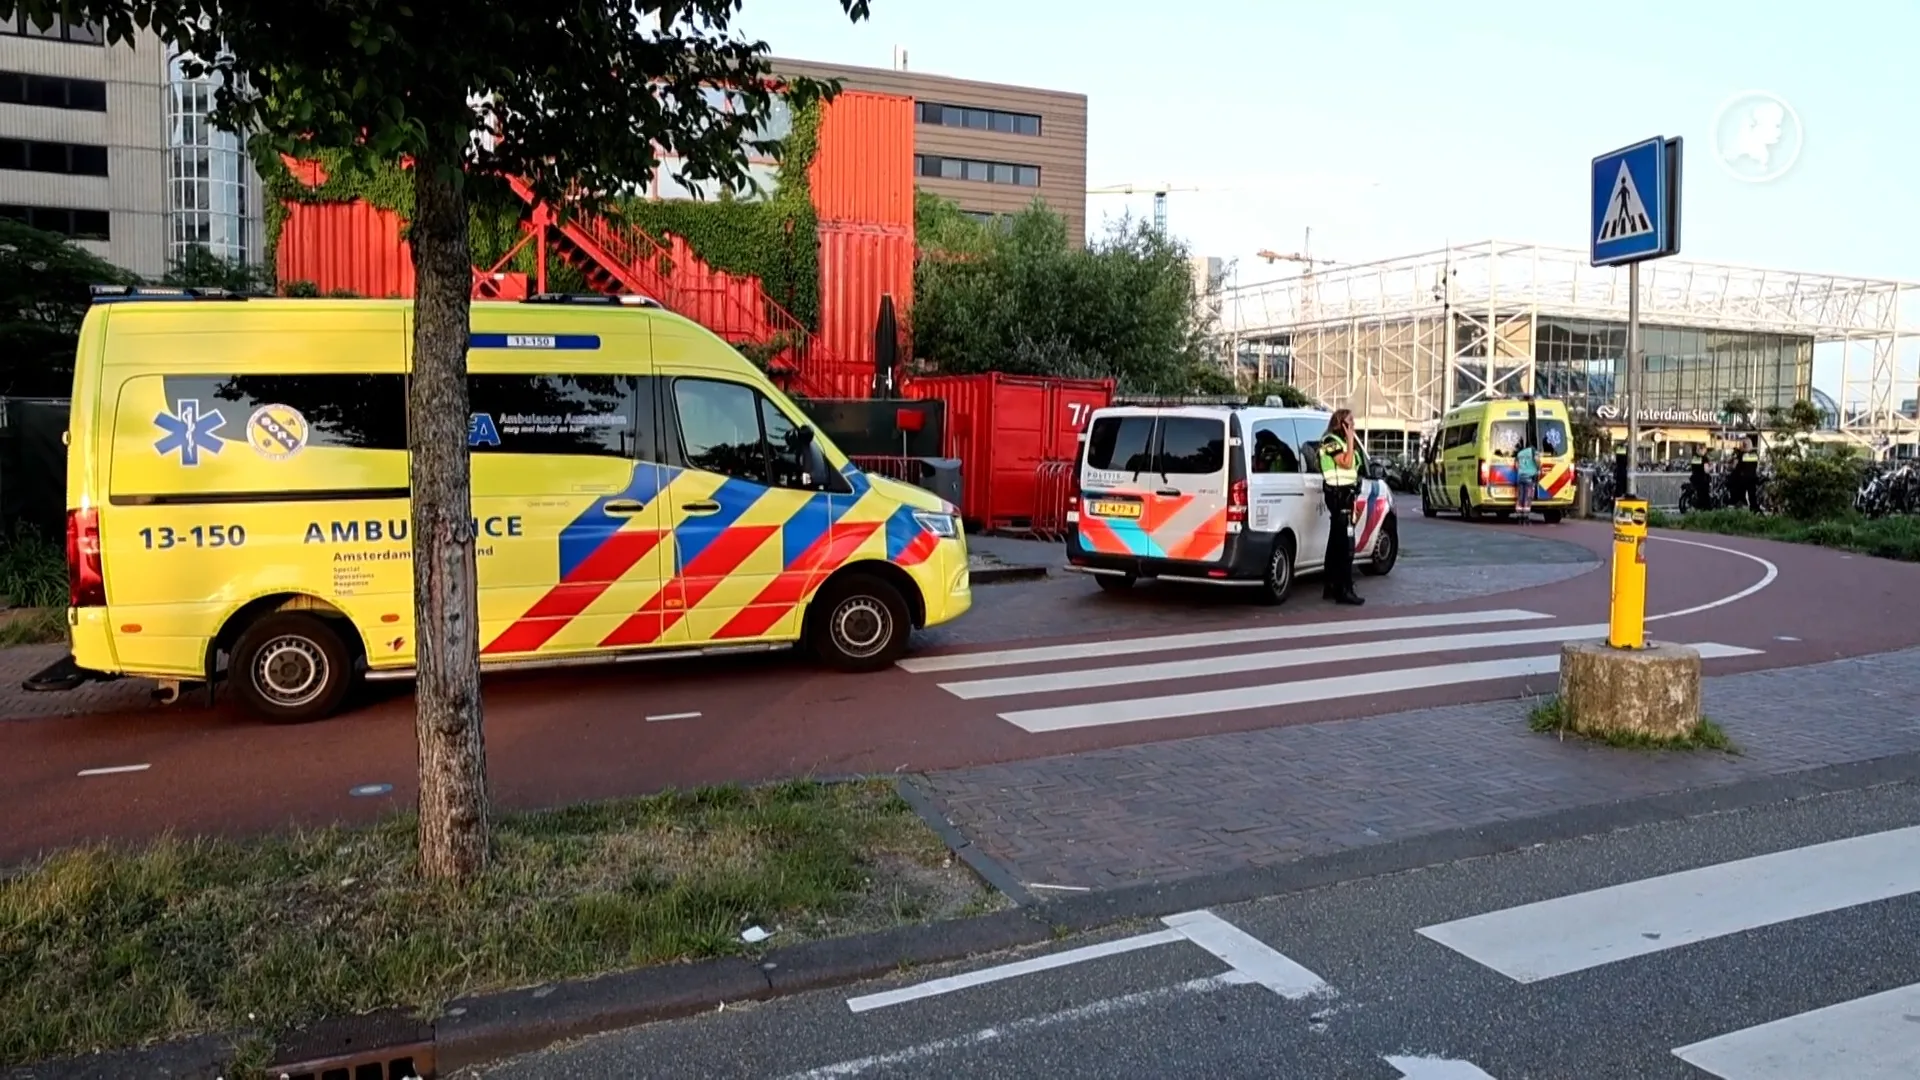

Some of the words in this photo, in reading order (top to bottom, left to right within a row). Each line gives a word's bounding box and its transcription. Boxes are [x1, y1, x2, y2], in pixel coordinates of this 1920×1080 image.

[514, 335, 550, 346] 13-150
[499, 412, 562, 425] Ambulance
[564, 412, 628, 425] Amsterdam
[303, 515, 523, 544] AMBUCE
[138, 524, 246, 549] 13-150
[333, 566, 360, 574] Special
[333, 573, 375, 581] Operations
[333, 580, 369, 588] Response
